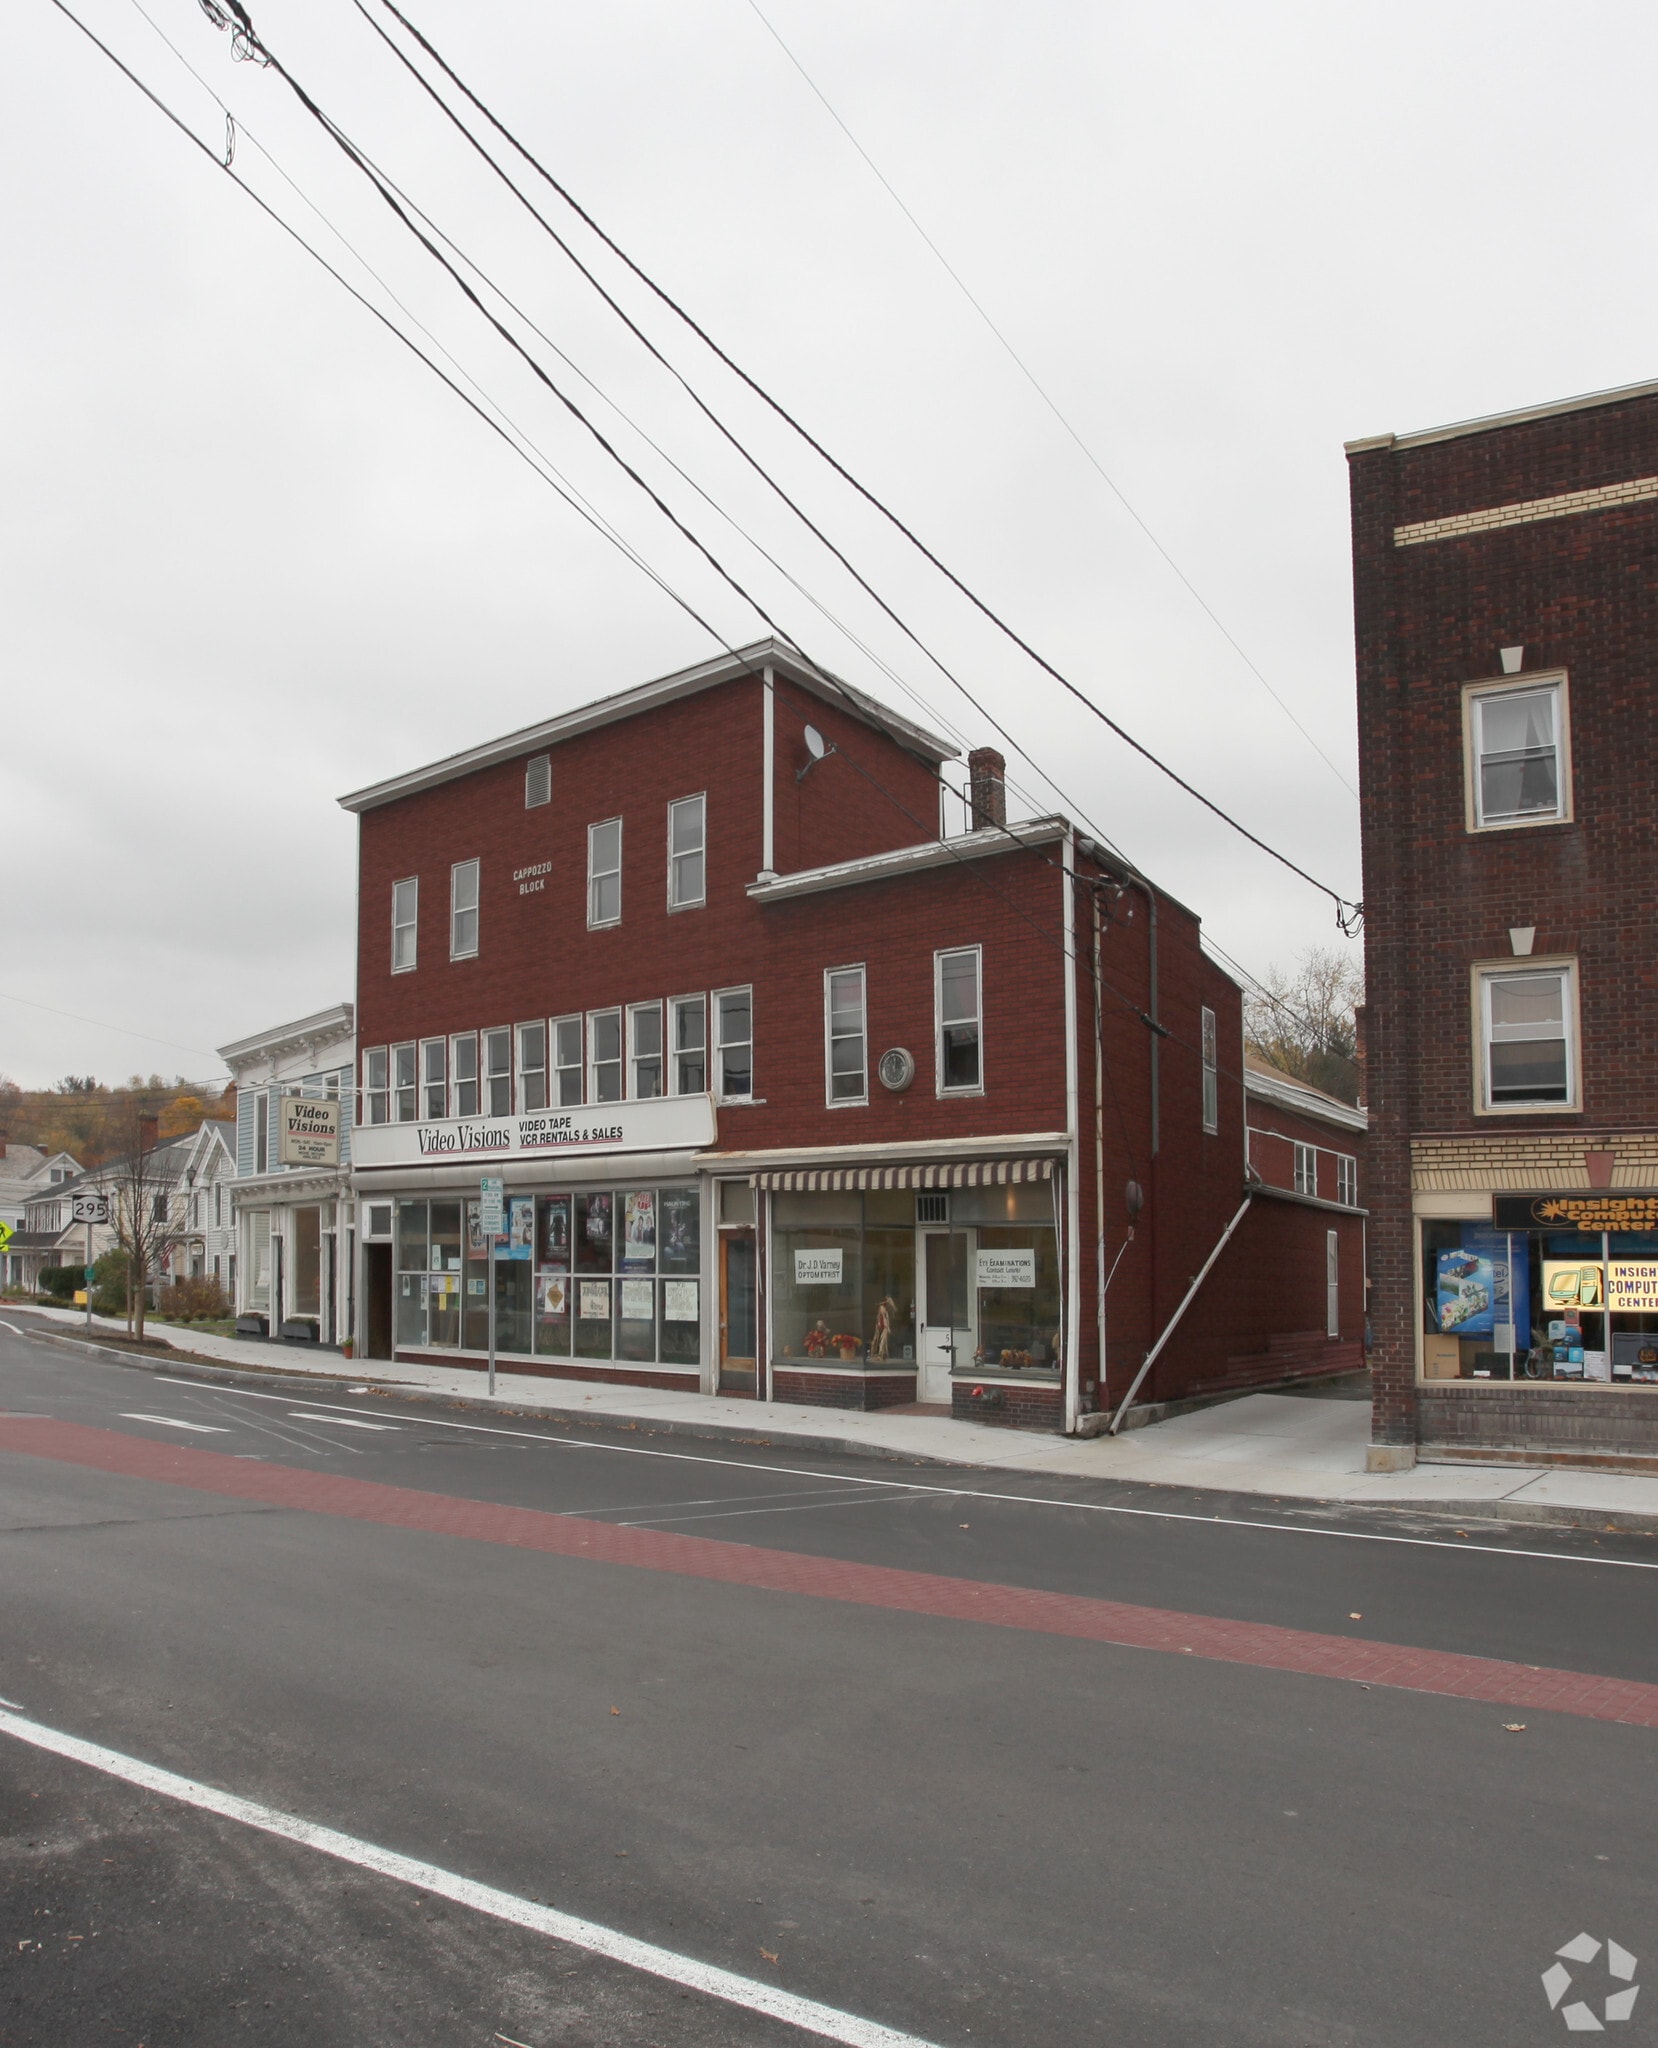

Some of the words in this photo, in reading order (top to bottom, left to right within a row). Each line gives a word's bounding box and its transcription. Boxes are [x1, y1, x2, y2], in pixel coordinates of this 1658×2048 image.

[513, 861, 552, 881] CAPPOZZO
[519, 879, 545, 895] BLOCK
[294, 1104, 329, 1120] Video
[288, 1118, 335, 1134] Visions
[519, 1119, 546, 1132] VIDEO
[549, 1117, 571, 1129] TAPE
[417, 1129, 455, 1155] Video
[457, 1125, 510, 1152] Visions
[520, 1133, 537, 1145] VCR
[540, 1130, 580, 1143] RENTALS
[583, 1129, 589, 1140] &
[592, 1126, 623, 1140] SALES
[482, 1180, 488, 1190] 2
[75, 1202, 106, 1216] 295
[1559, 1198, 1658, 1212] Insight
[1567, 1210, 1658, 1222] Comput
[1577, 1220, 1655, 1231] Center
[1614, 1267, 1658, 1277] INSIGH
